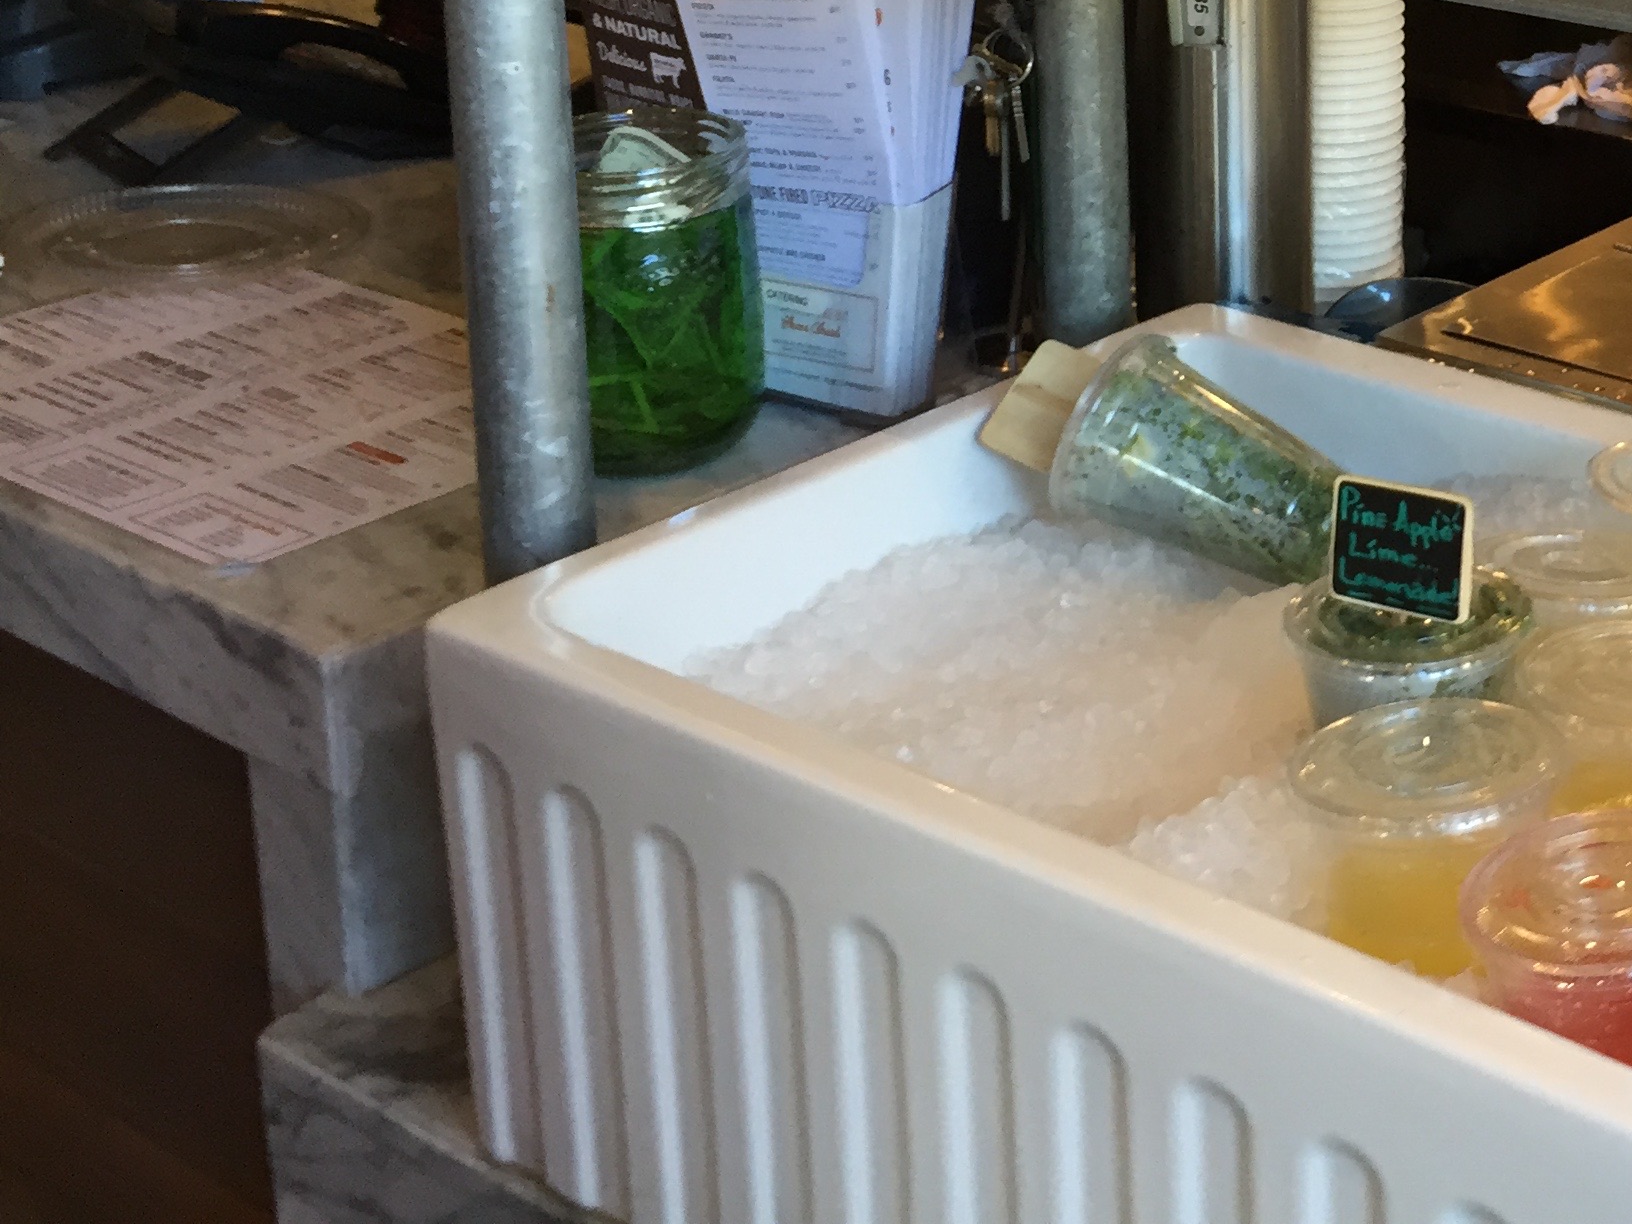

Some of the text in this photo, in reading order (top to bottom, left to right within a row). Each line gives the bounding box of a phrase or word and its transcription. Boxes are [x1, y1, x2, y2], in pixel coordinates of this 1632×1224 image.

[603, 15, 682, 51] NATURAL
[596, 41, 647, 72] Delicious
[1339, 485, 1388, 528] Pine
